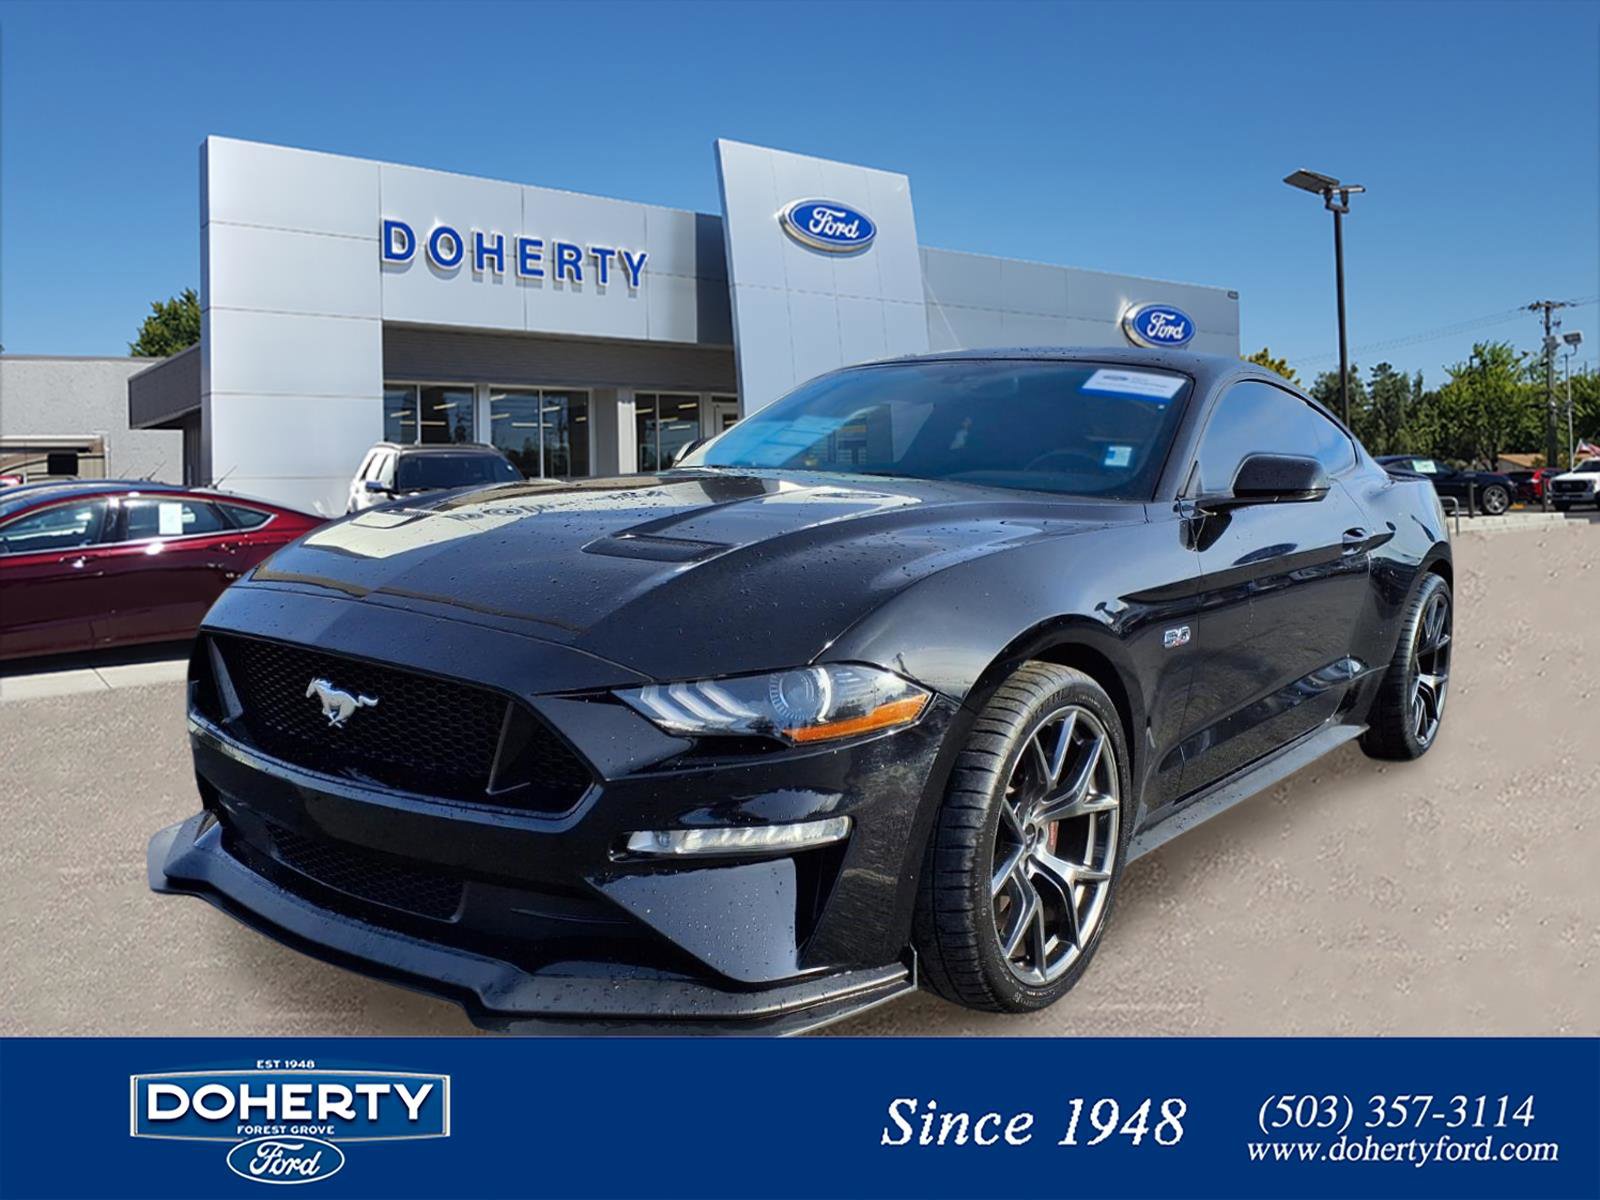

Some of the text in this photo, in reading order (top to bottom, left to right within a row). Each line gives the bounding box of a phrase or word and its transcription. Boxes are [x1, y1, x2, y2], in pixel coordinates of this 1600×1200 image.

[808, 206, 859, 239] Ford
[382, 218, 648, 288] DOHERTY
[1146, 311, 1186, 340] Ford
